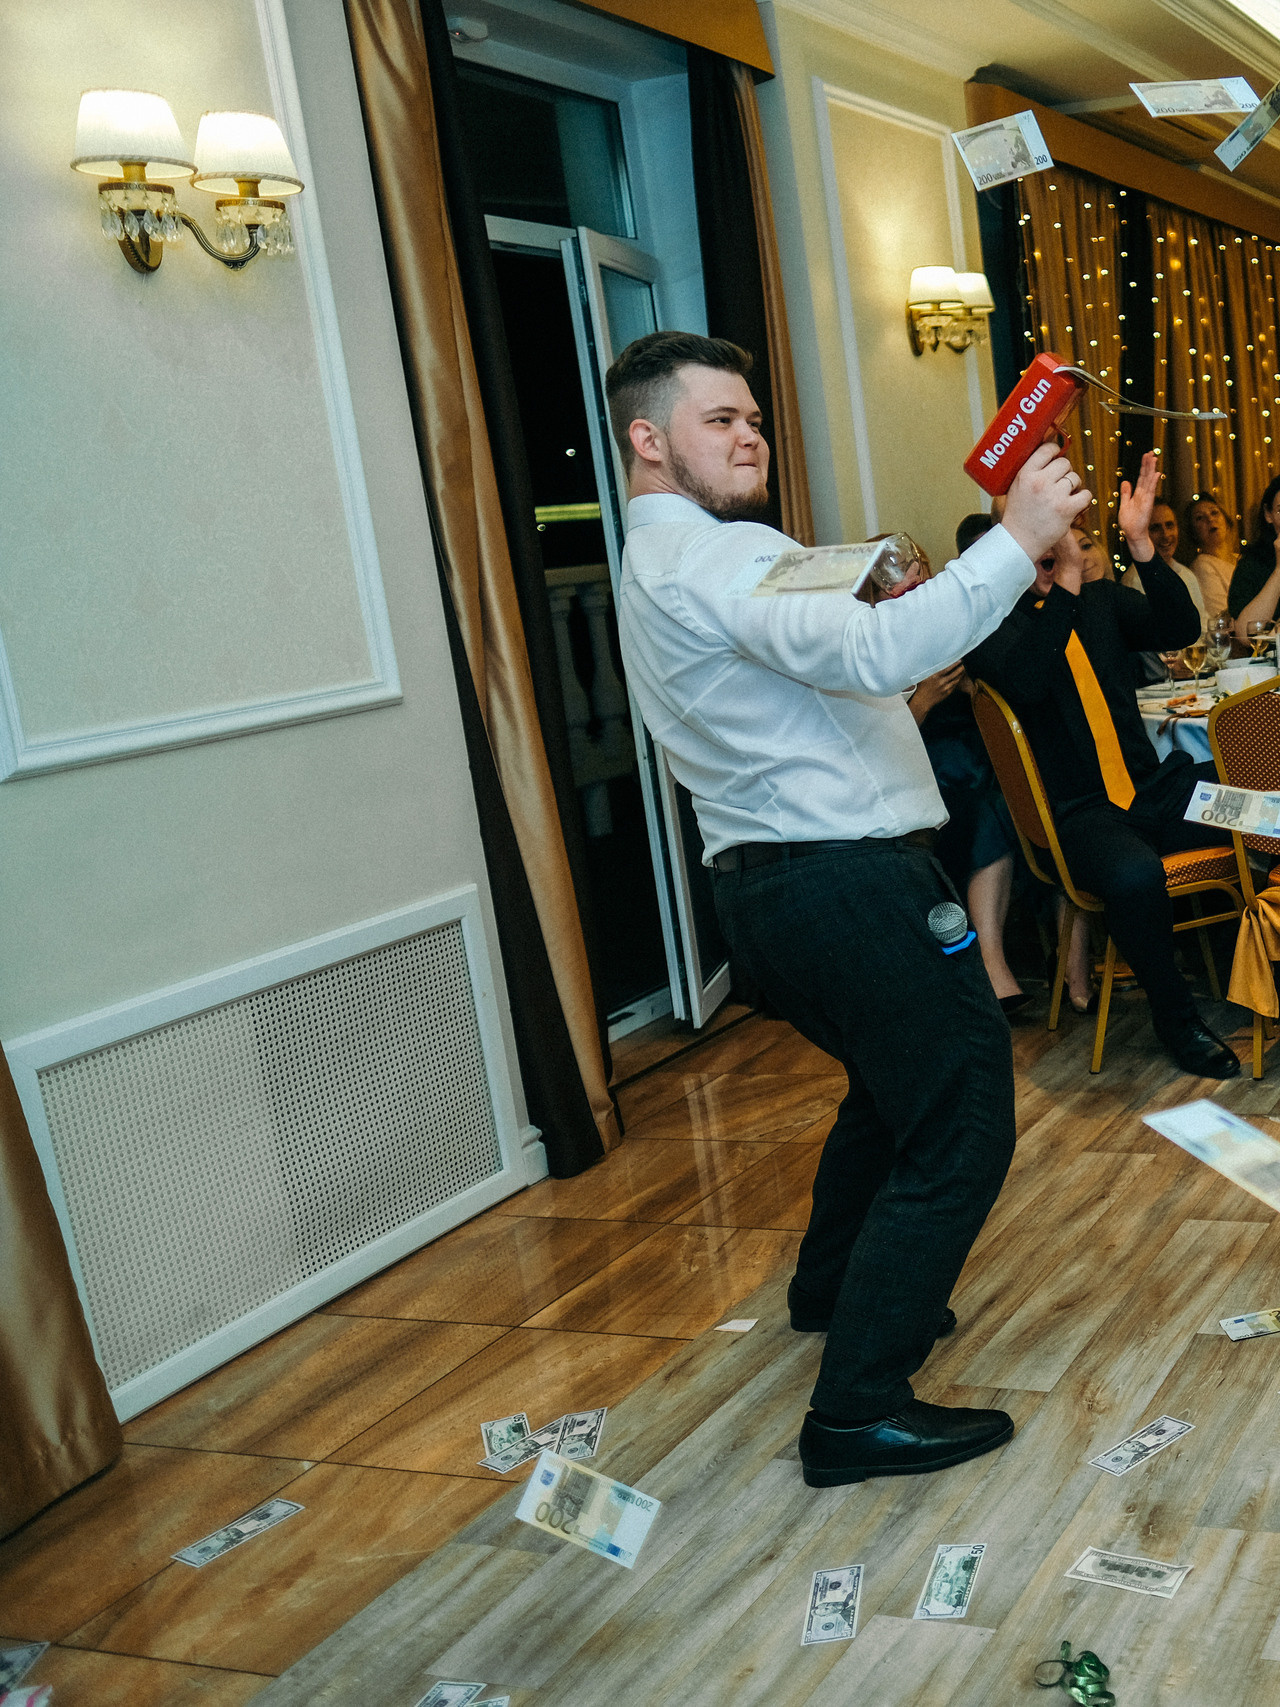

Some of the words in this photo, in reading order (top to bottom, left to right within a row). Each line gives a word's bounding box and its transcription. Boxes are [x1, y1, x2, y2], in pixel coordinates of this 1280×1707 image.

[1034, 154, 1048, 166] 200
[976, 173, 994, 186] 200
[979, 413, 1027, 469] Money
[1019, 378, 1052, 414] Gun
[755, 554, 778, 563] 200
[1201, 809, 1240, 827] 200
[635, 1496, 653, 1512] 200
[535, 1501, 572, 1534] 200
[971, 1544, 984, 1555] 50
